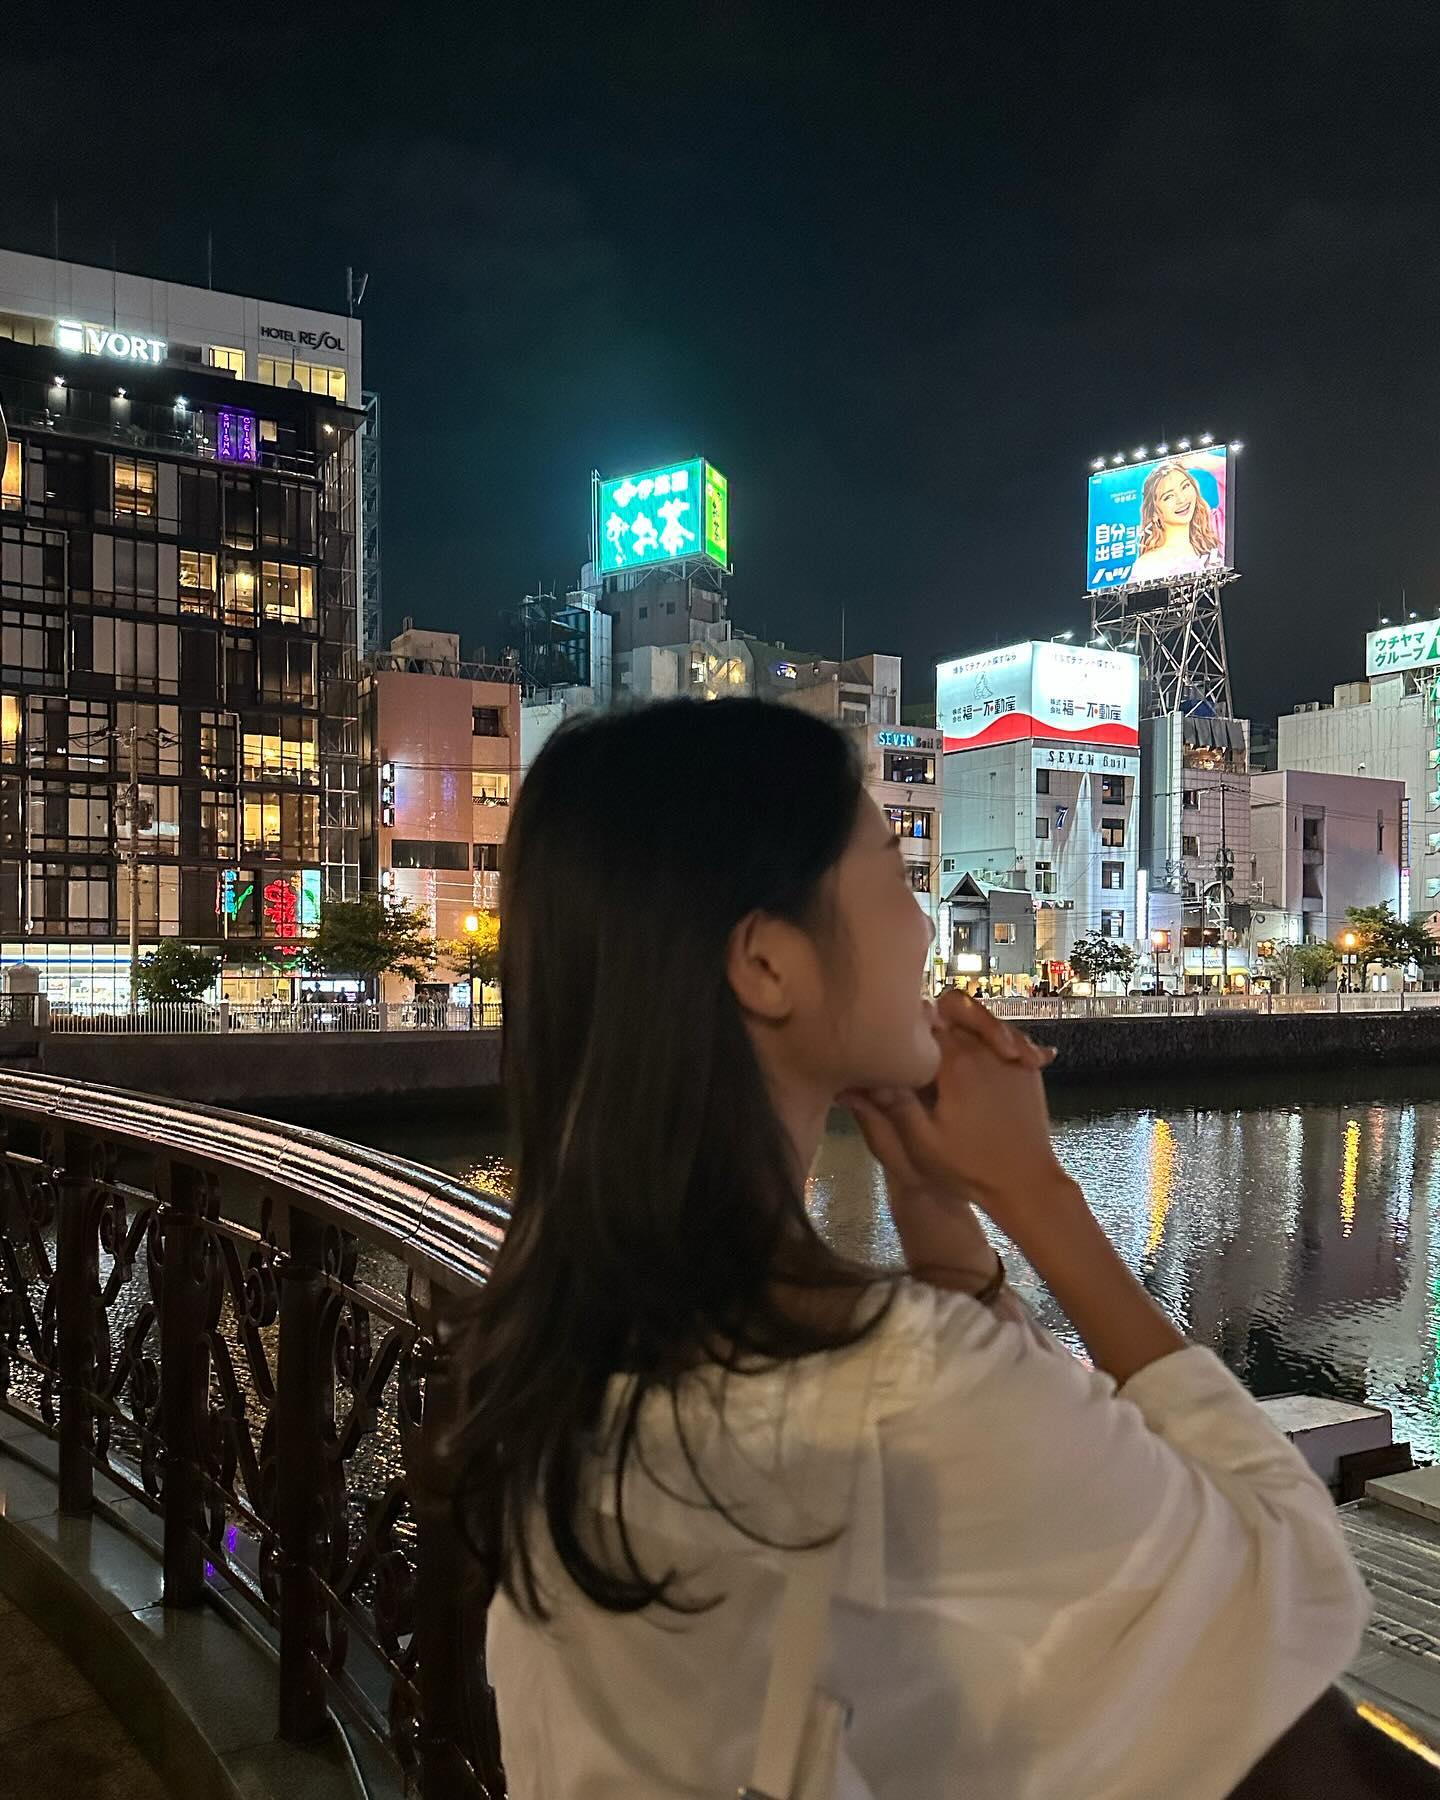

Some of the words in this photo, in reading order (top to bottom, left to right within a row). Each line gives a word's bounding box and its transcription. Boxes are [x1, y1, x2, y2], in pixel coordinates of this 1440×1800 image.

[86, 329, 167, 363] VORT
[261, 326, 296, 342] HOTEL
[299, 331, 345, 351] RESOL
[1375, 632, 1425, 651] ウチヤマ
[1375, 645, 1425, 667] グループ
[963, 695, 1016, 721] 福一不動産
[1063, 699, 1122, 721] 福一不動産
[879, 732, 914, 747] SEVEN
[1048, 751, 1094, 766] SEVEN
[1056, 805, 1069, 830] 7
